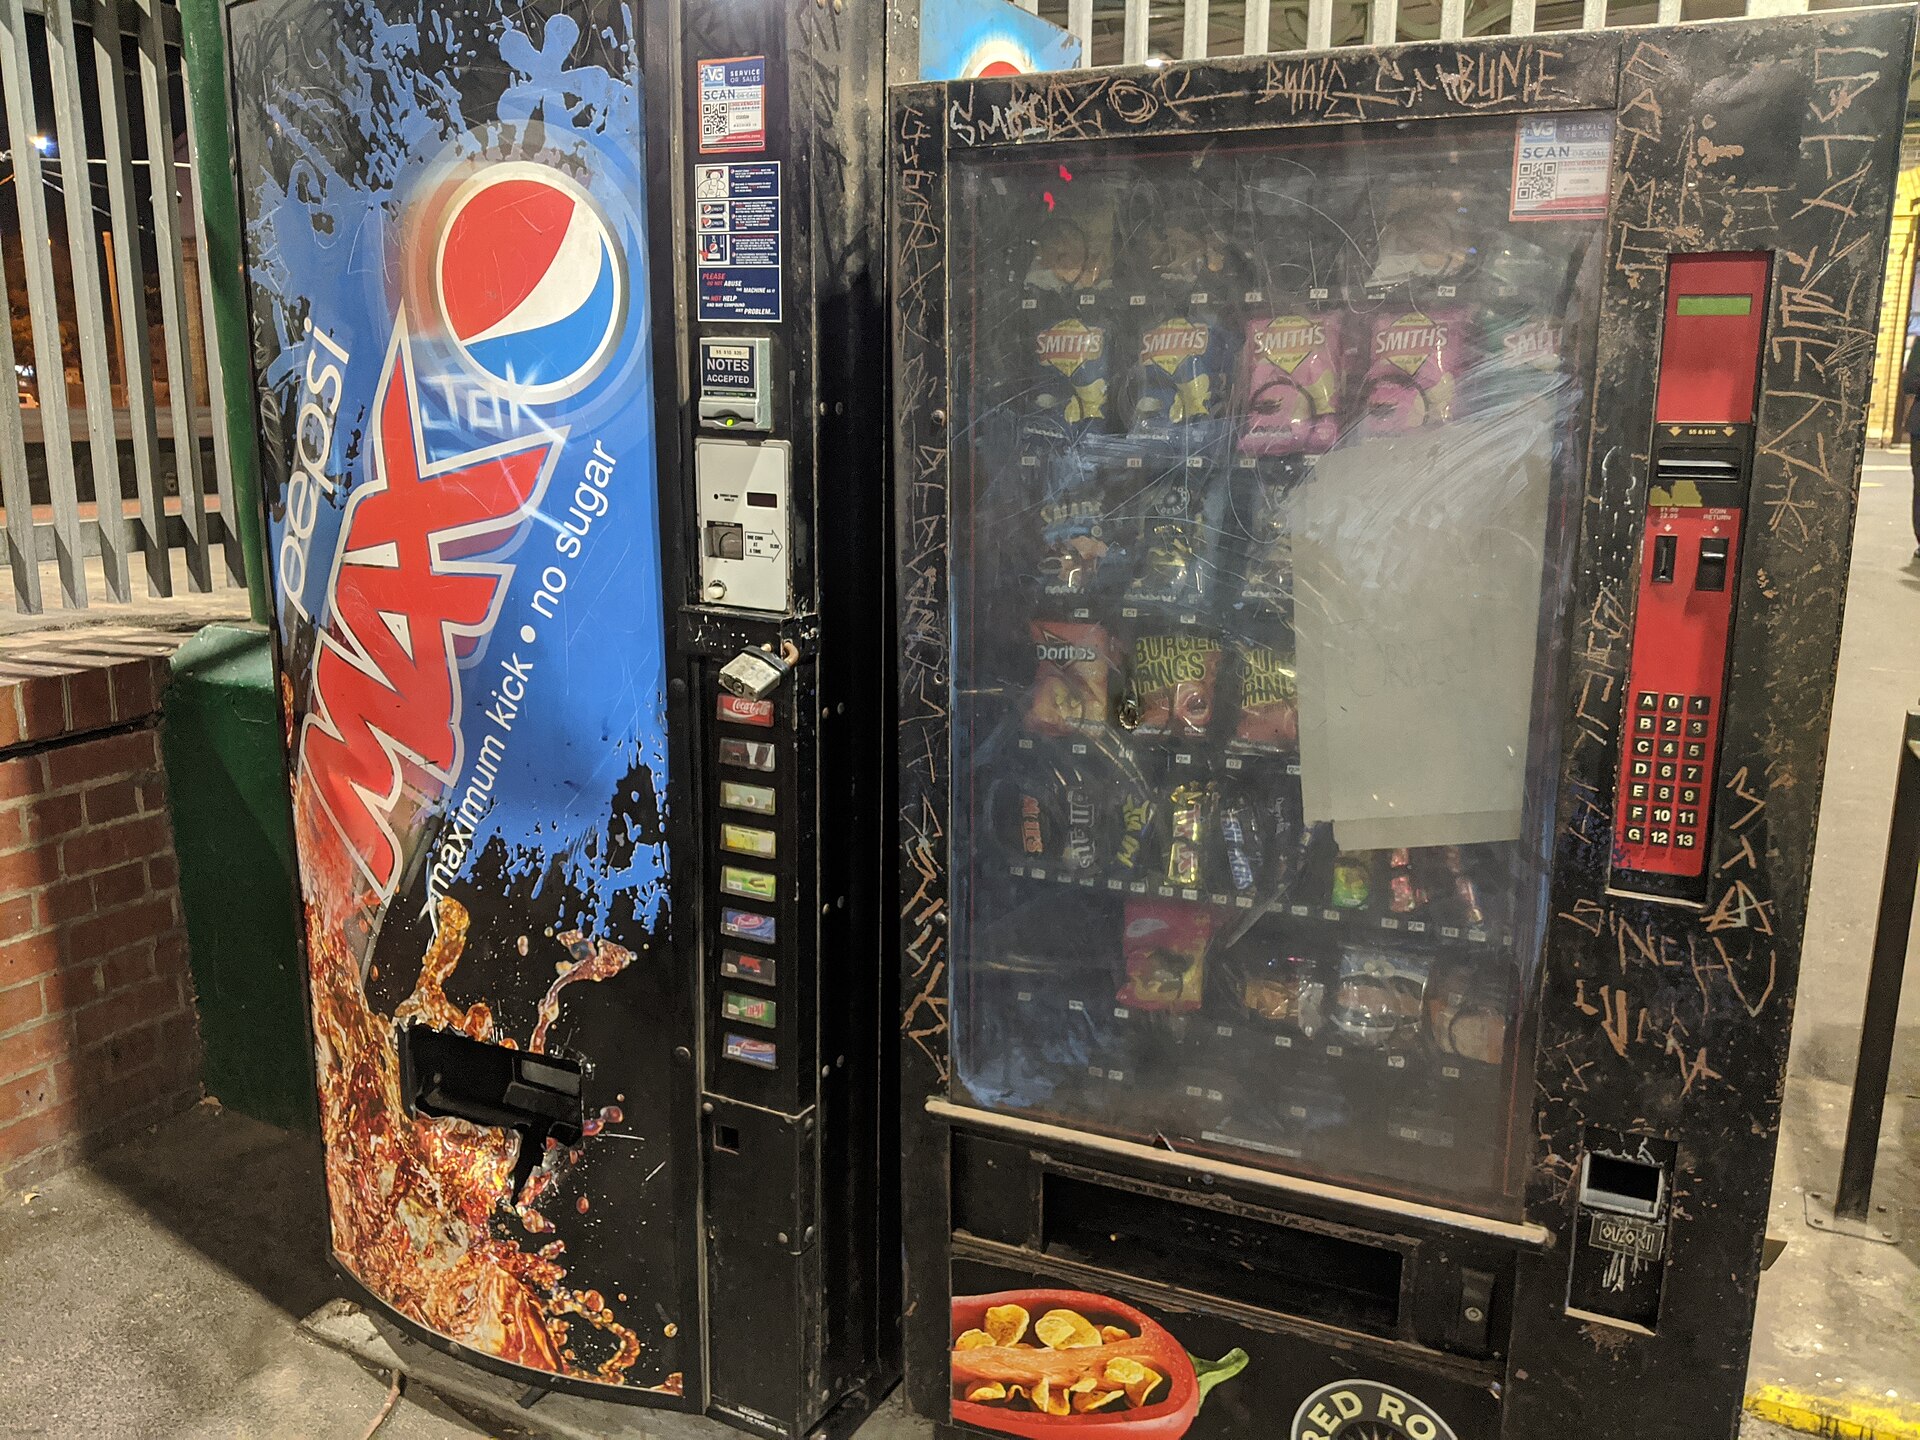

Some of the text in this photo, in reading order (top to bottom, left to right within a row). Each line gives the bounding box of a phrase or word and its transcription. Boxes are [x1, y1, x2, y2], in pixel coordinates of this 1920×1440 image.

[730, 69, 760, 77] SERVICE
[704, 89, 735, 100] SCAN
[1564, 123, 1610, 131] SERVICE
[1522, 146, 1570, 158] SCAN
[702, 272, 726, 280] PLEASE
[1036, 332, 1102, 355] SMITH'S
[1141, 330, 1207, 355] SMITH'S
[1254, 324, 1326, 354] SMITH'S
[1375, 325, 1449, 355] SMITH'S
[707, 359, 750, 372] NOTES
[707, 374, 750, 384] ACCEPTED
[280, 316, 350, 623] pepsi
[299, 302, 571, 892] MAX
[1036, 644, 1096, 662] Doritos
[429, 439, 618, 900] maximum kick no sugar
[1132, 652, 1207, 696] RINGS
[1642, 695, 1703, 709] A 0 1
[1640, 718, 1702, 734] B 2 3
[1637, 741, 1699, 757] C 4 5
[1635, 763, 1696, 779] D 6 7
[1633, 785, 1694, 802] E 8 9
[1632, 807, 1695, 823] F 10 11
[1628, 829, 1693, 846] G 12 13
[1301, 1390, 1364, 1440] RED
